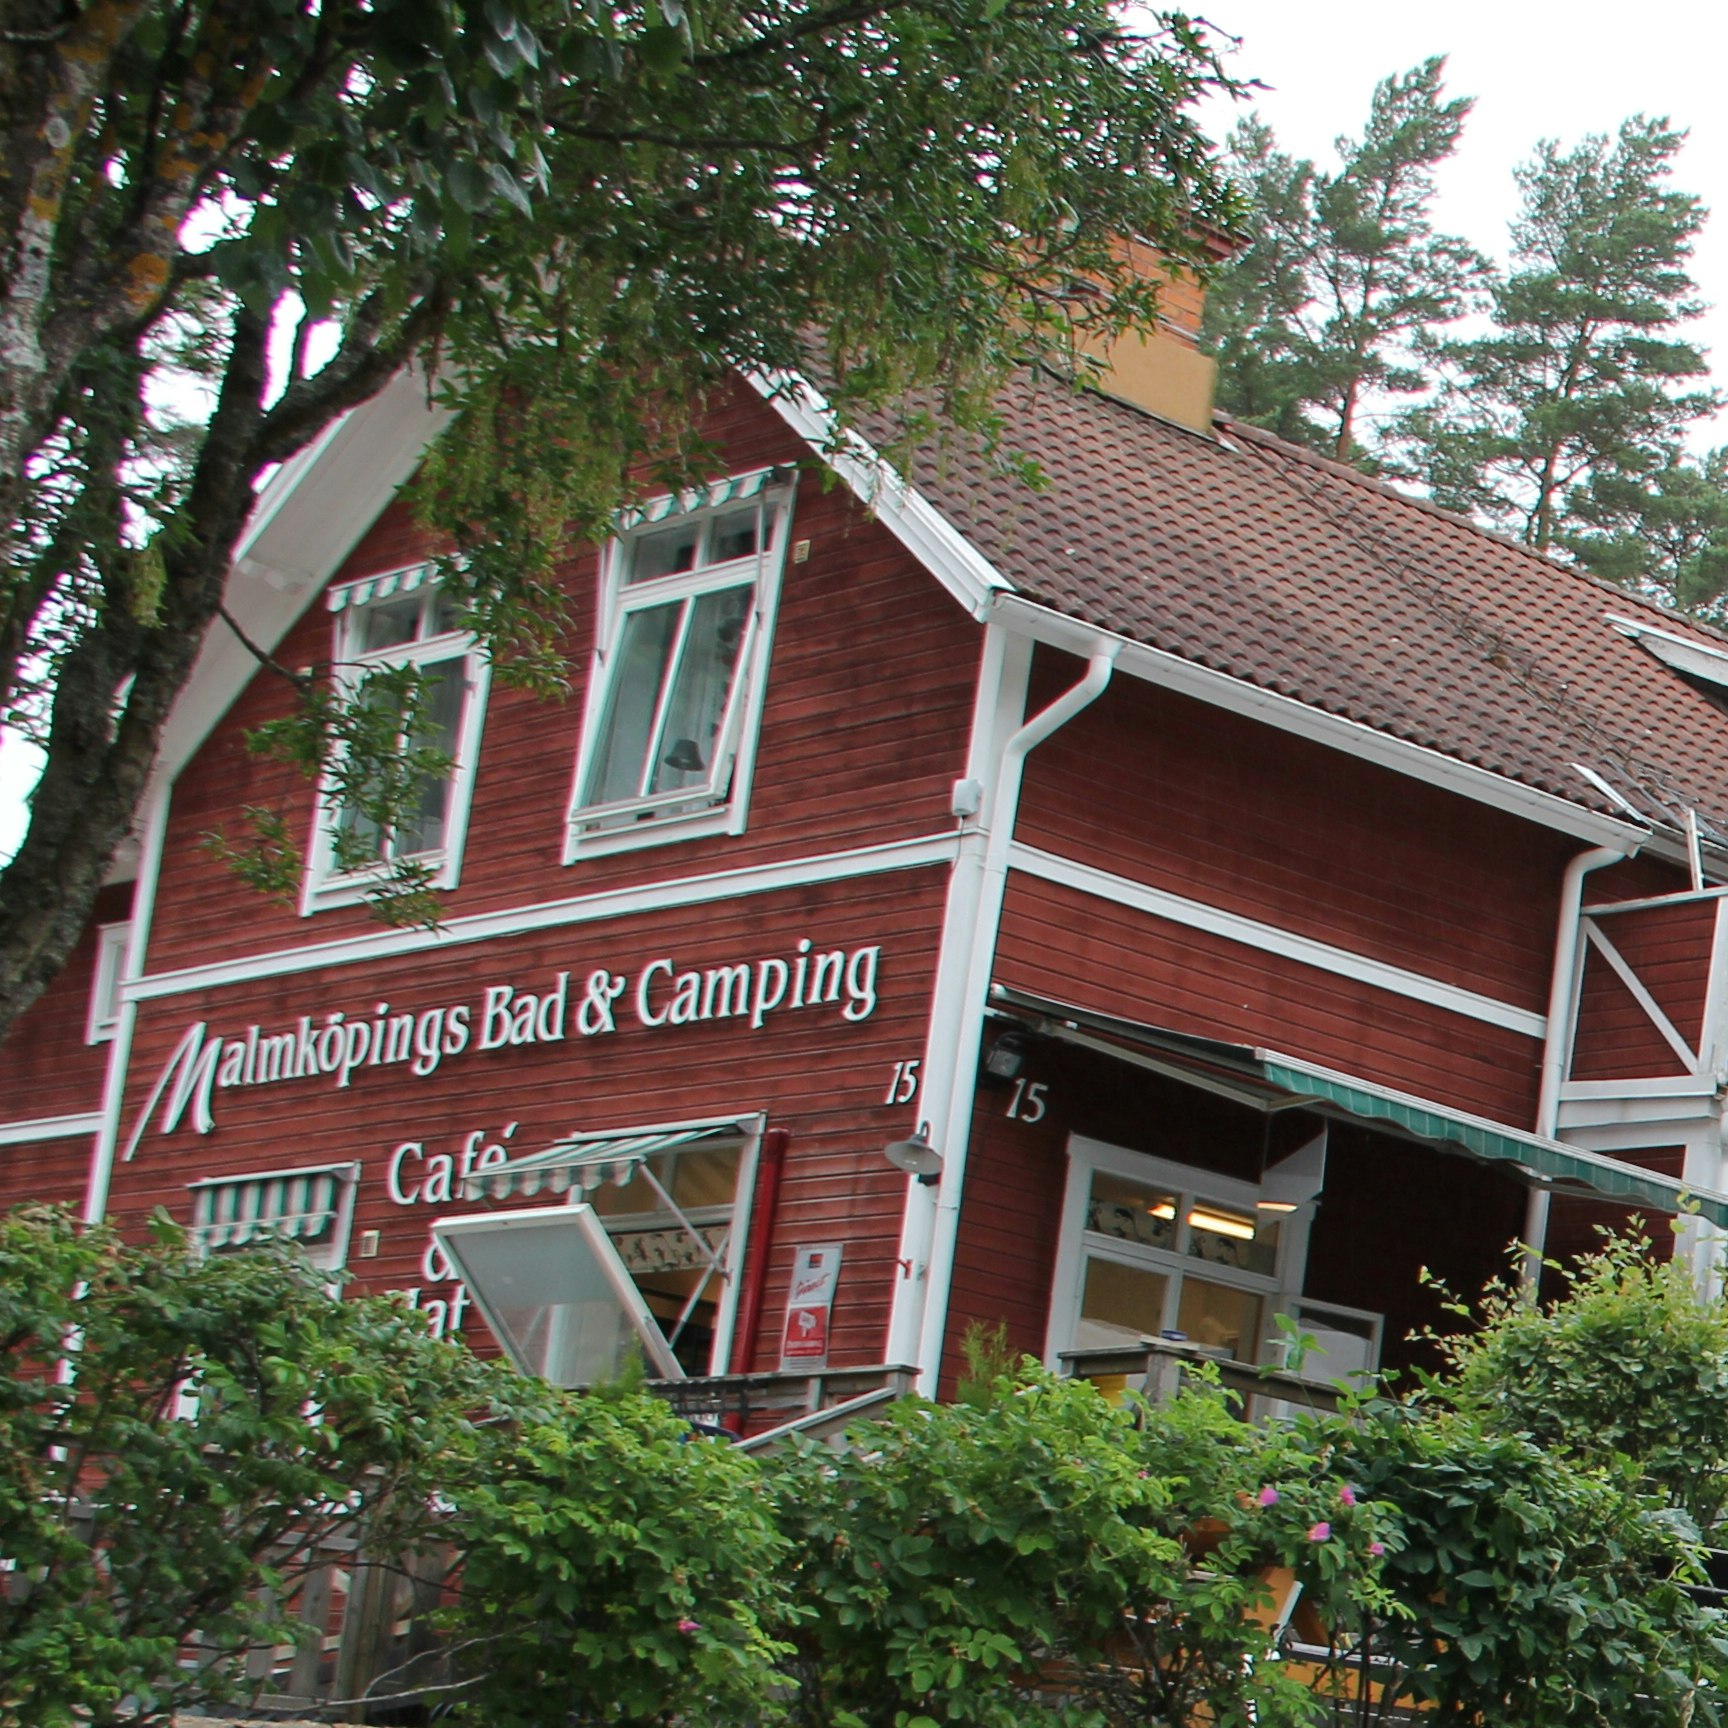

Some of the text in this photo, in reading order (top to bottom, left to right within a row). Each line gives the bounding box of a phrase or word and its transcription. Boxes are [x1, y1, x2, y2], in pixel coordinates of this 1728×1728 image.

[122, 938, 882, 1162] Malmköpings Bad & Camping
[885, 1060, 921, 1105] 15
[1006, 1077, 1049, 1123] 15
